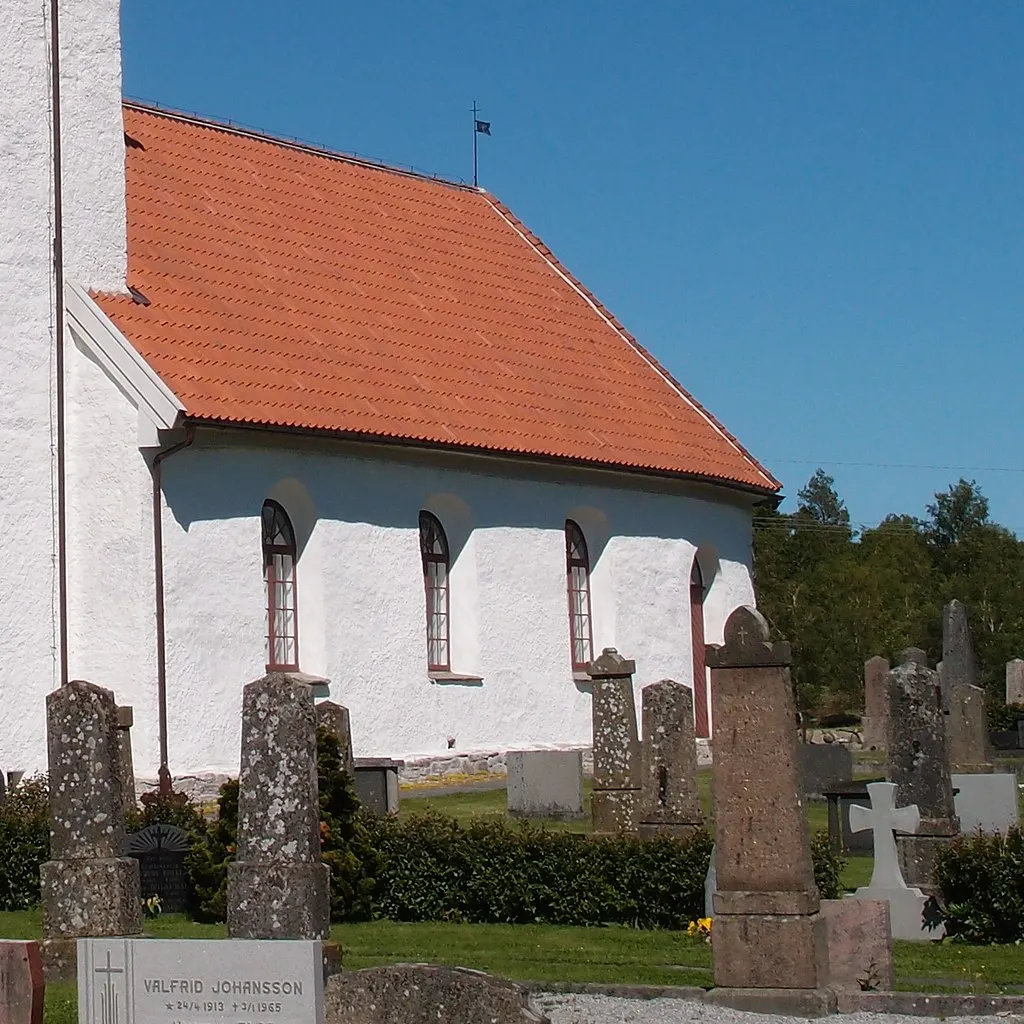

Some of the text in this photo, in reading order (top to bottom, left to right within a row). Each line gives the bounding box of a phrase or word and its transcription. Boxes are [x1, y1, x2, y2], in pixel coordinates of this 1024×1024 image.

[144, 979, 304, 996] VALFRID JOHANSSON
[177, 1001, 200, 1012] 24/4
[203, 1001, 225, 1012] 1913
[257, 1002, 282, 1013] 1965
